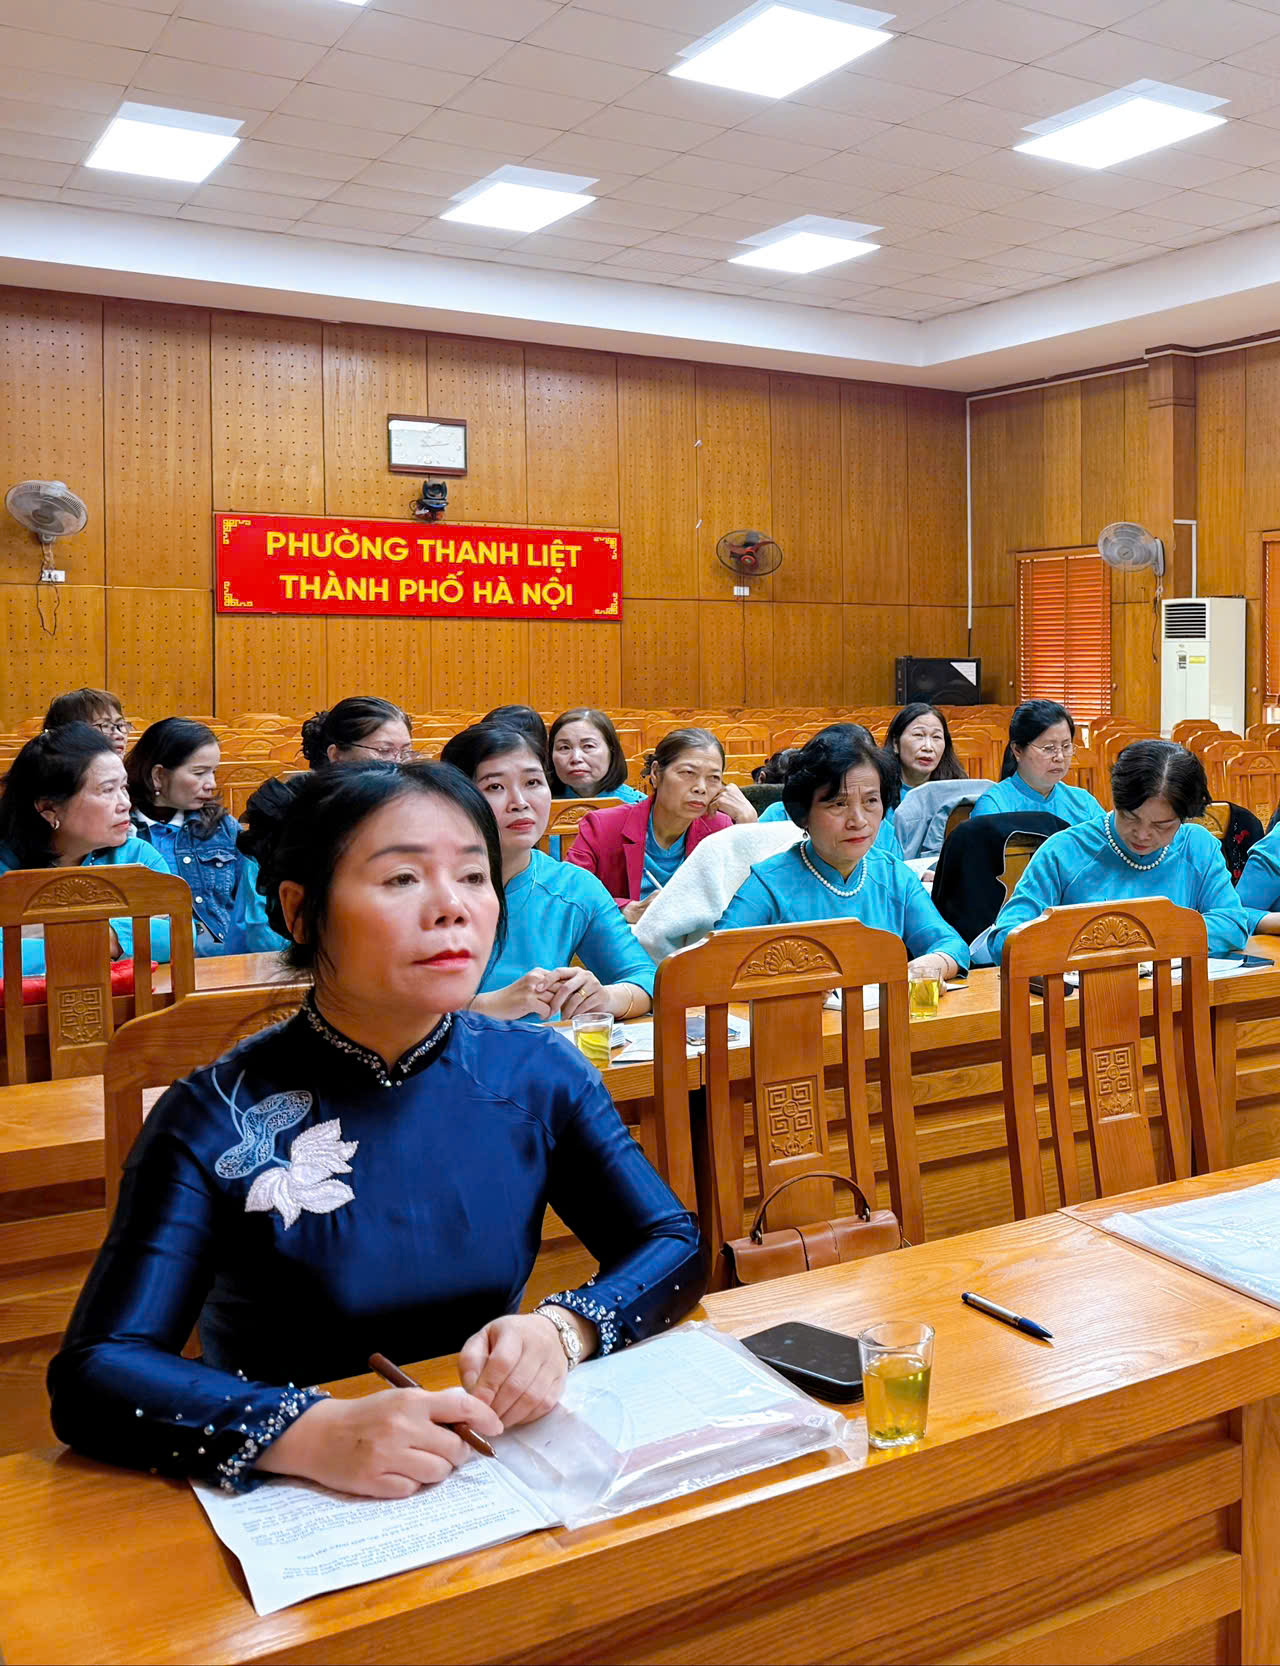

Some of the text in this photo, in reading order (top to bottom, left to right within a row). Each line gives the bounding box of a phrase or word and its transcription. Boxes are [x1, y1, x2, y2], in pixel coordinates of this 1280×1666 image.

[266, 528, 582, 573] PHƯỜNG THANH LIỆT
[280, 570, 573, 611] THÀNH PHỐ HÀ NỘI
